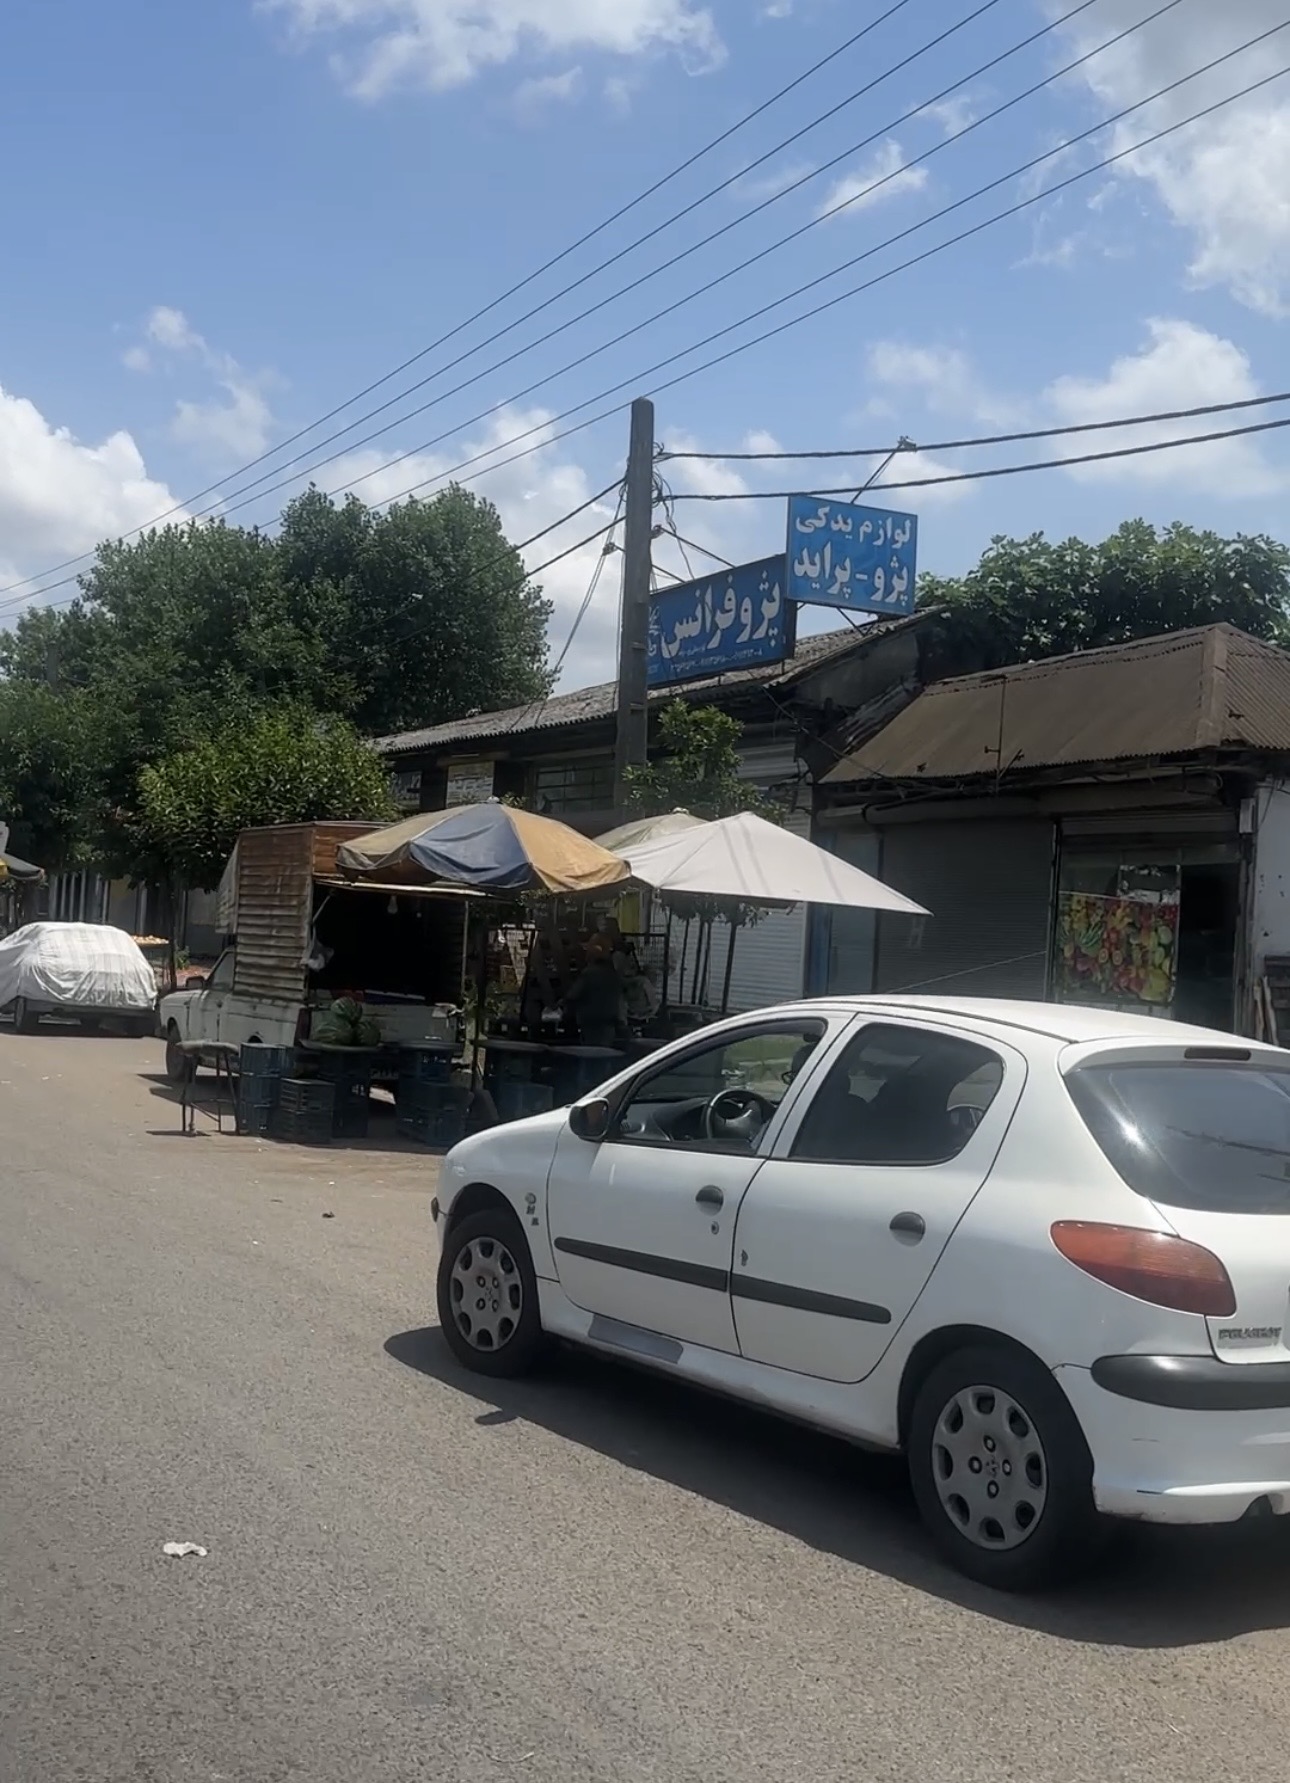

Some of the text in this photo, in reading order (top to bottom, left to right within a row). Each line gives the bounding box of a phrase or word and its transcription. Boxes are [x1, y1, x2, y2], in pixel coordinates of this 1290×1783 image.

[796, 506, 911, 549] لوازم یدکی
[794, 541, 852, 599] پراید
[870, 556, 909, 606] پژو
[735, 570, 780, 647] پژو
